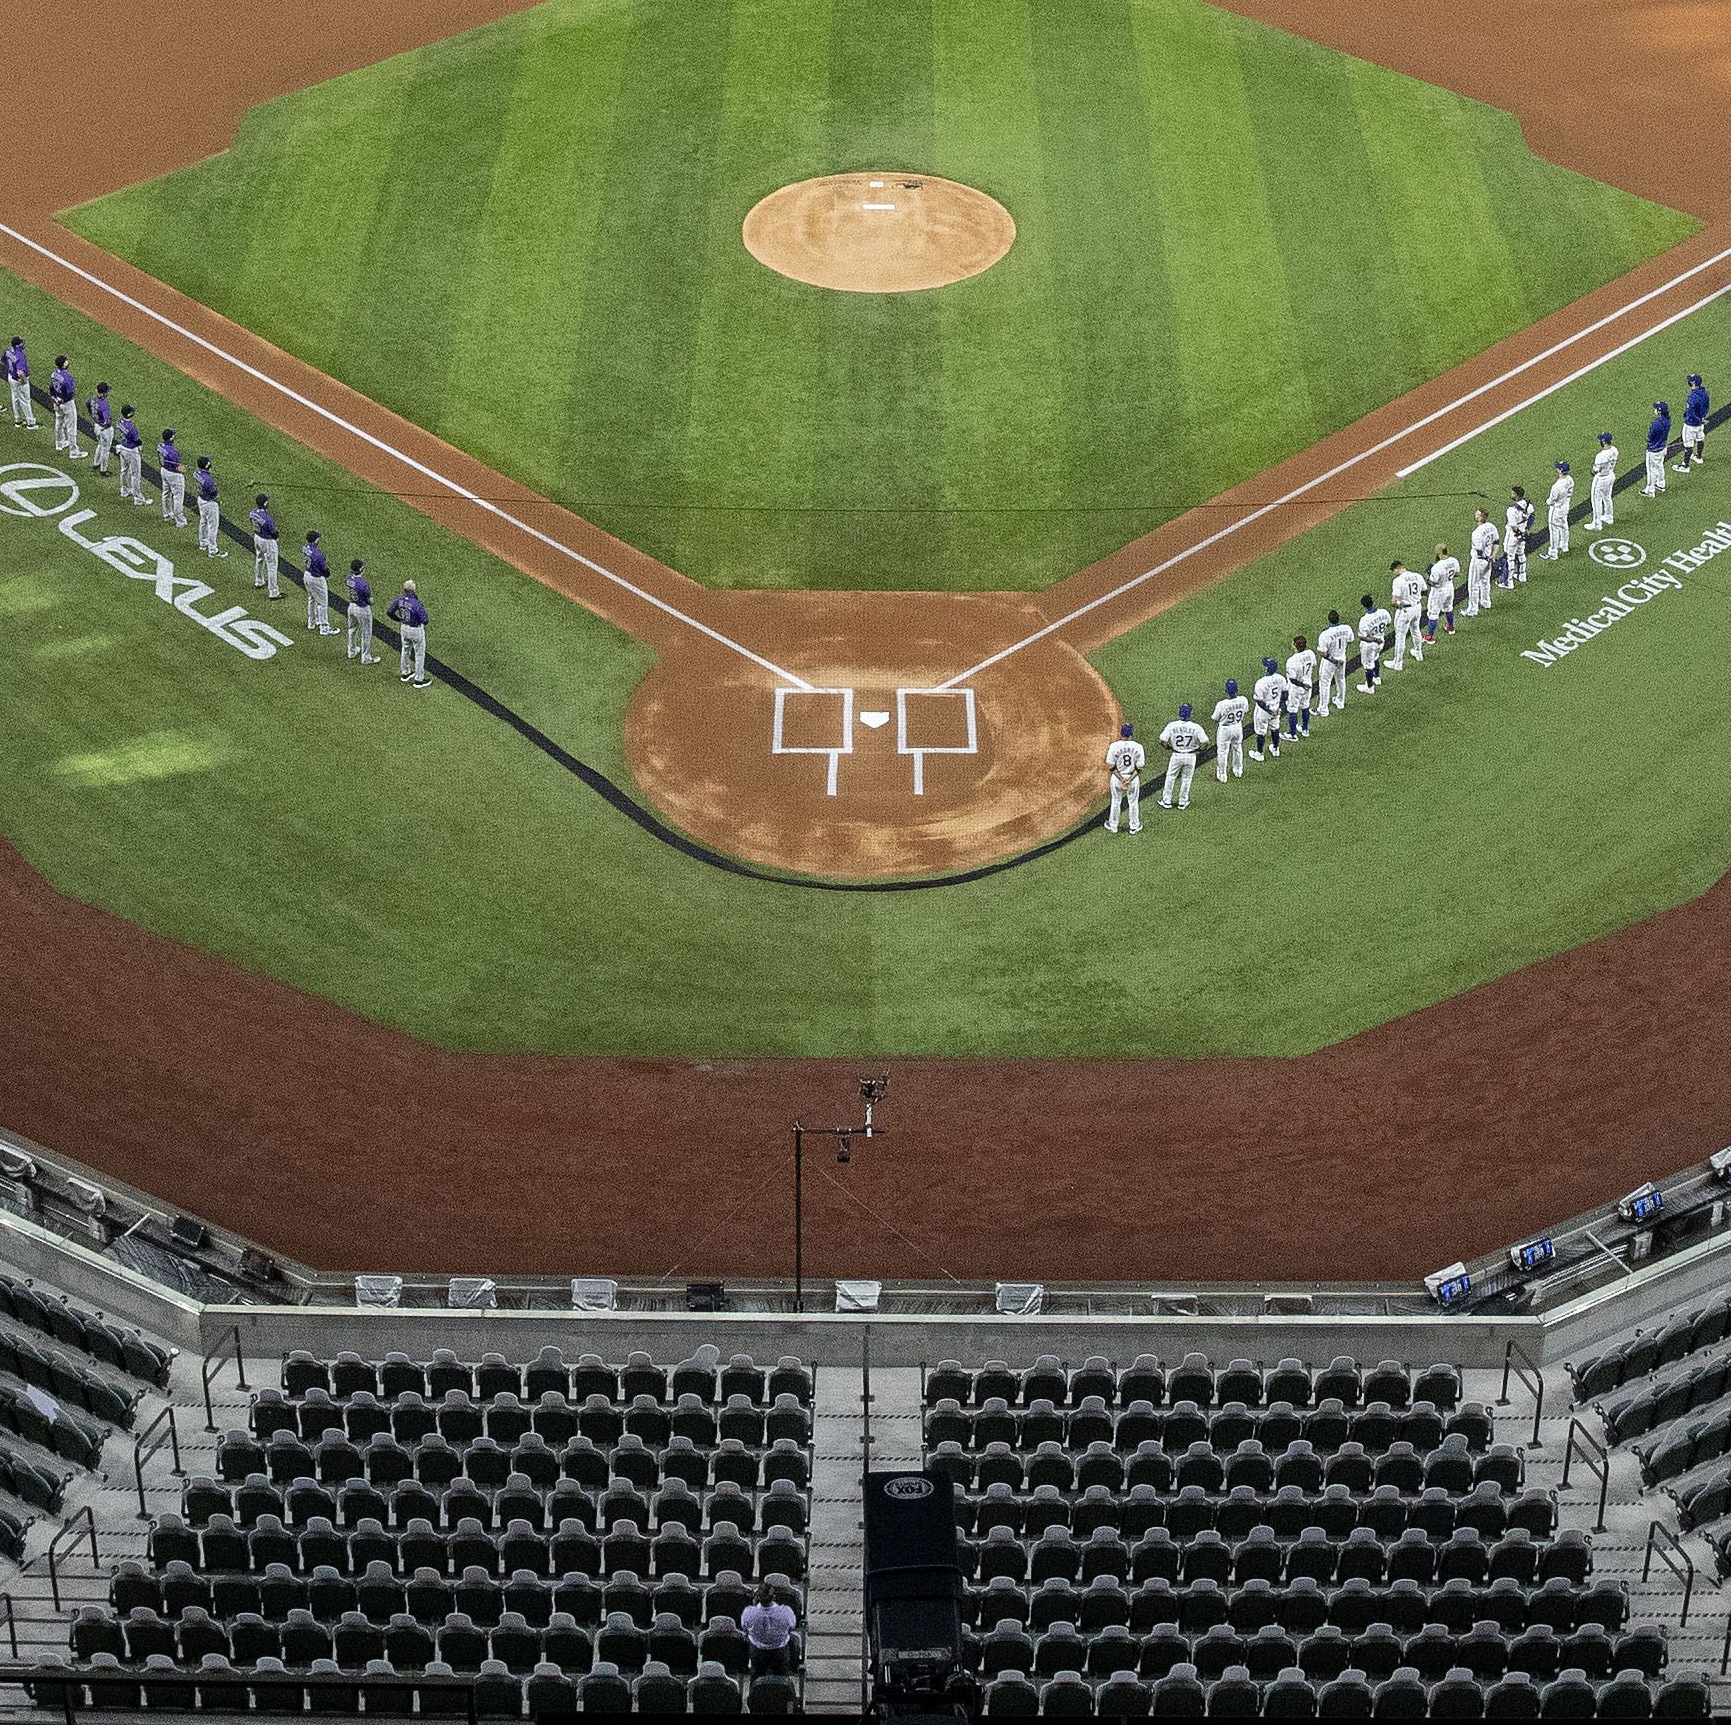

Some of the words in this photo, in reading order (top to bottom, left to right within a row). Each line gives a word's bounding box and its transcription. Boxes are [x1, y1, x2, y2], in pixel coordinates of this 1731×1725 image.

[58, 509, 294, 660] LEXUS
[1407, 582, 1418, 595] 13
[1520, 595, 1637, 667] Medical
[1627, 567, 1684, 606] City
[1227, 710, 1243, 723] 99
[1175, 735, 1192, 747] 27
[1122, 754, 1132, 767] 8
[896, 1485, 923, 1495] FOX
